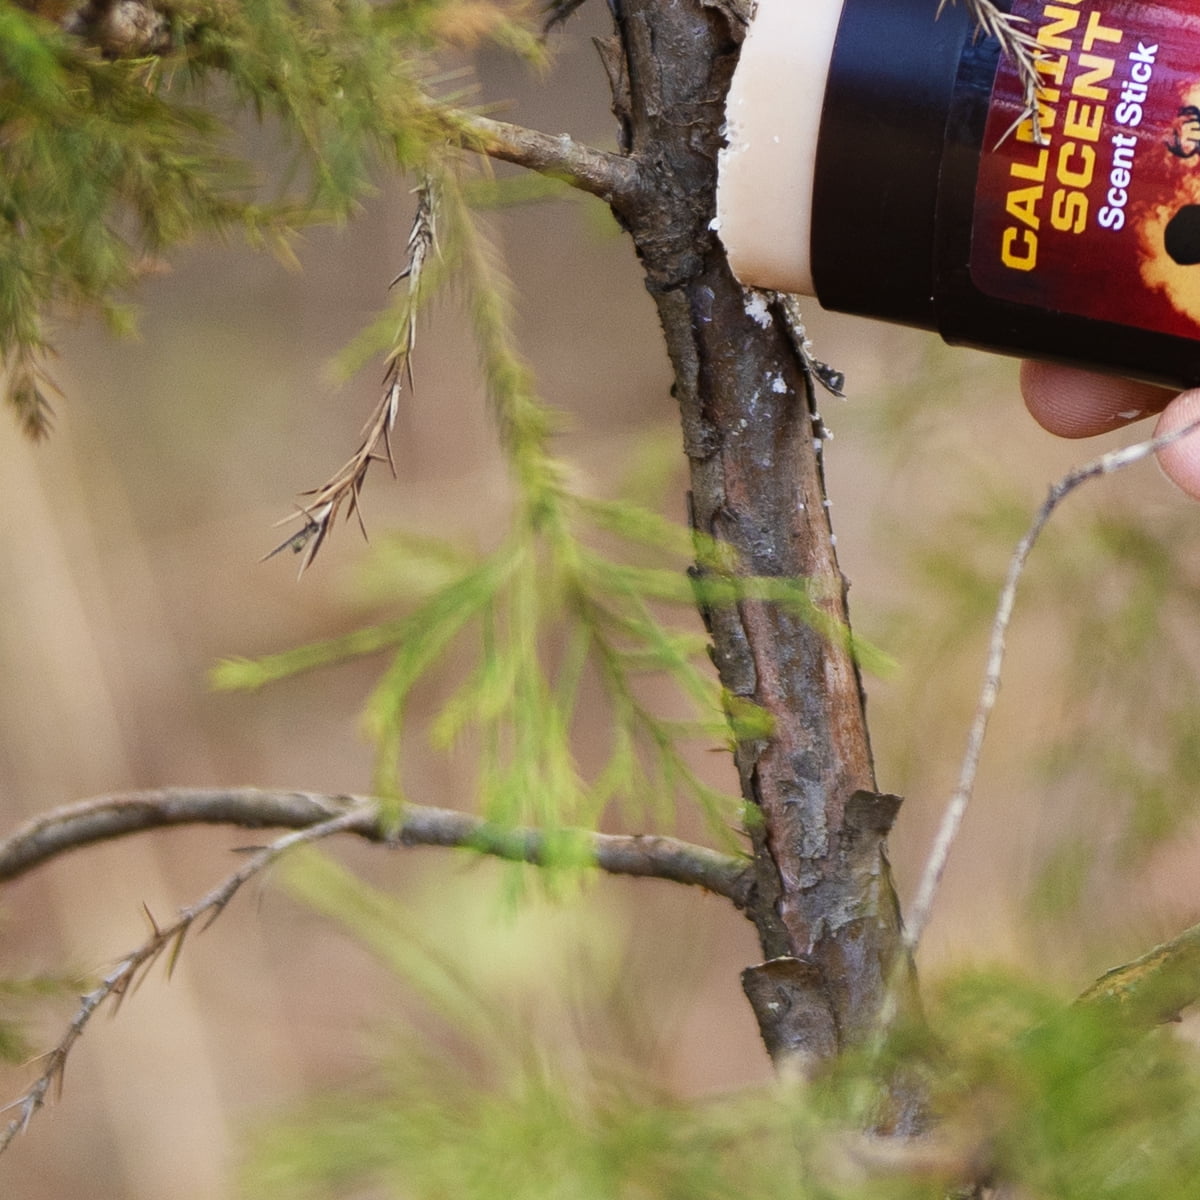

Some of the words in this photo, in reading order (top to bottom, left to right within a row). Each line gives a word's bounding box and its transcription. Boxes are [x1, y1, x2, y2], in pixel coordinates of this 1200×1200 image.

[1050, 11, 1123, 234] SCENT
[1115, 41, 1159, 127] Stick
[1098, 132, 1137, 231] Scent
